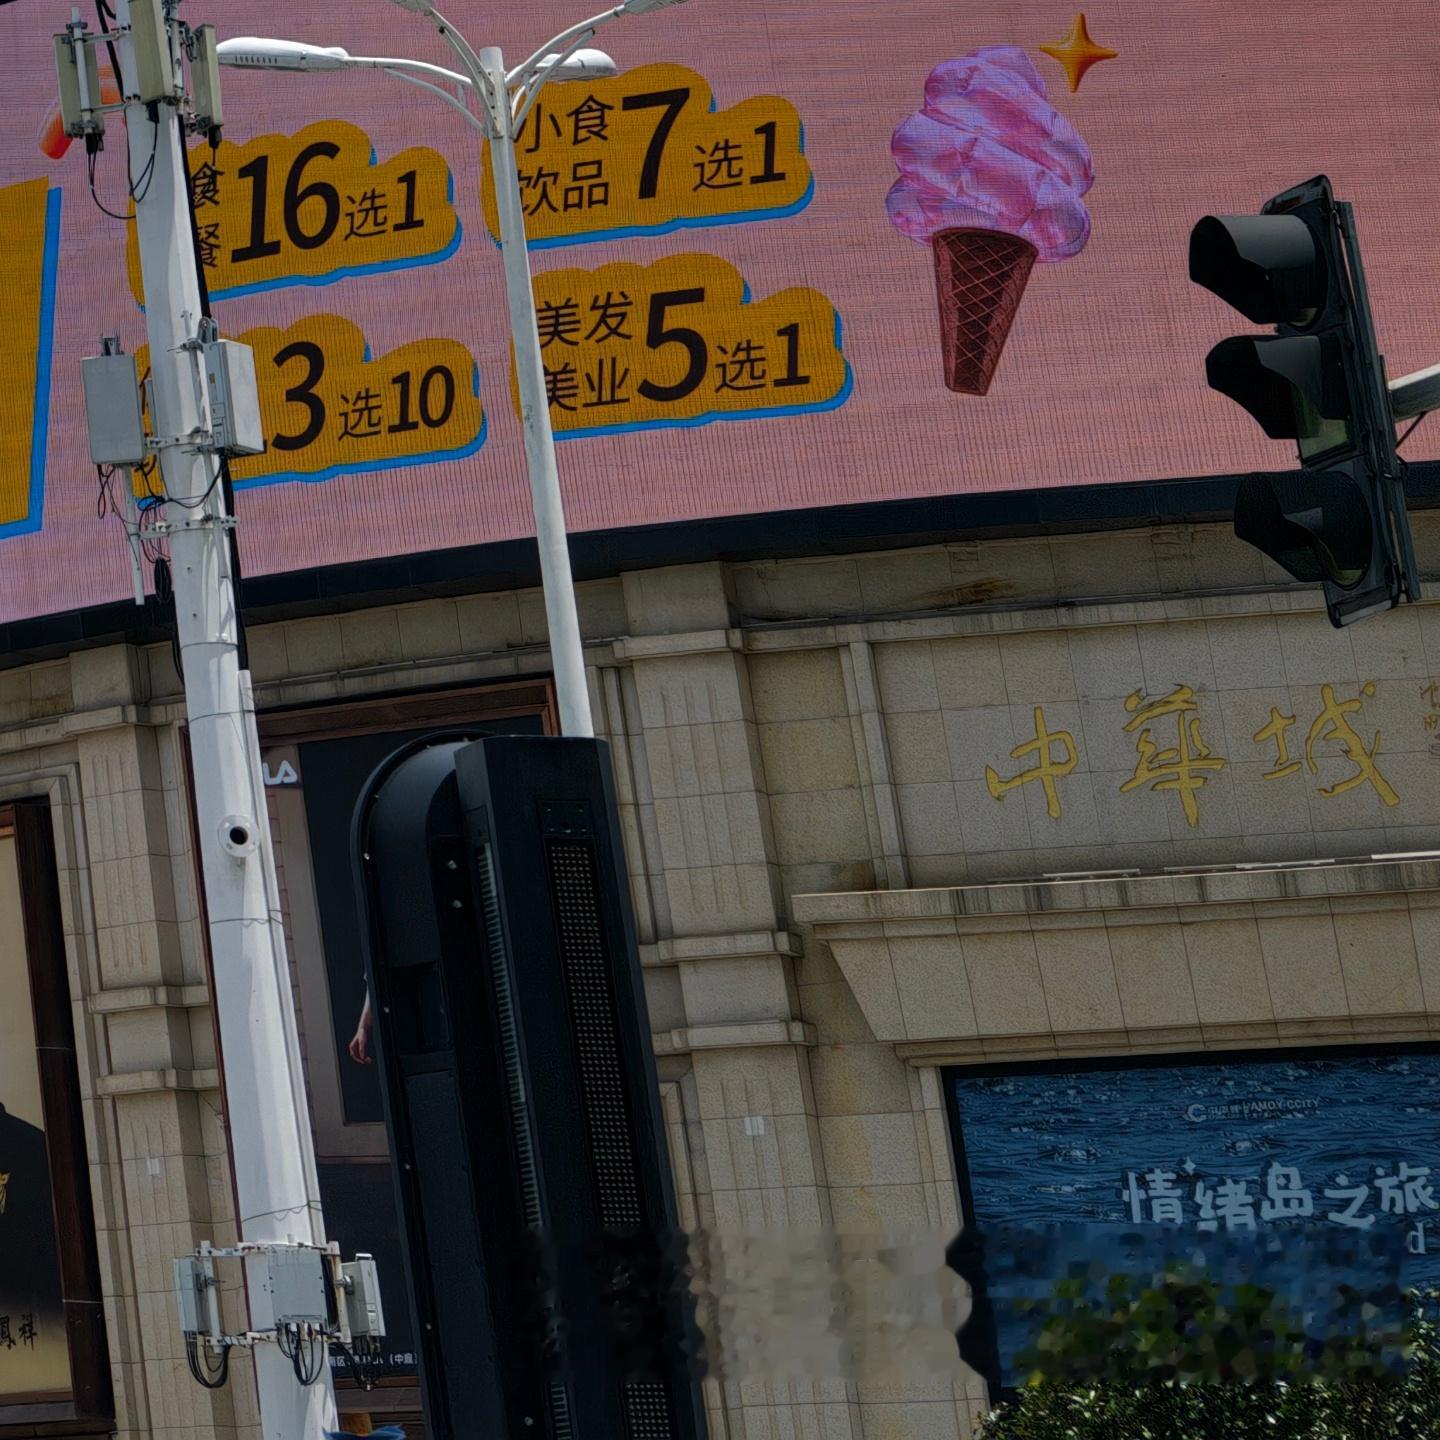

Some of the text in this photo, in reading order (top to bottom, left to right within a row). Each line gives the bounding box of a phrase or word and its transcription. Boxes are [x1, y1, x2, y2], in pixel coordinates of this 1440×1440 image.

[514, 94, 614, 154] 小食
[192, 161, 225, 210] 食
[536, 291, 633, 349] 美发
[543, 356, 630, 412] 美业
[1122, 1161, 1440, 1233] 情绪岛之旅
